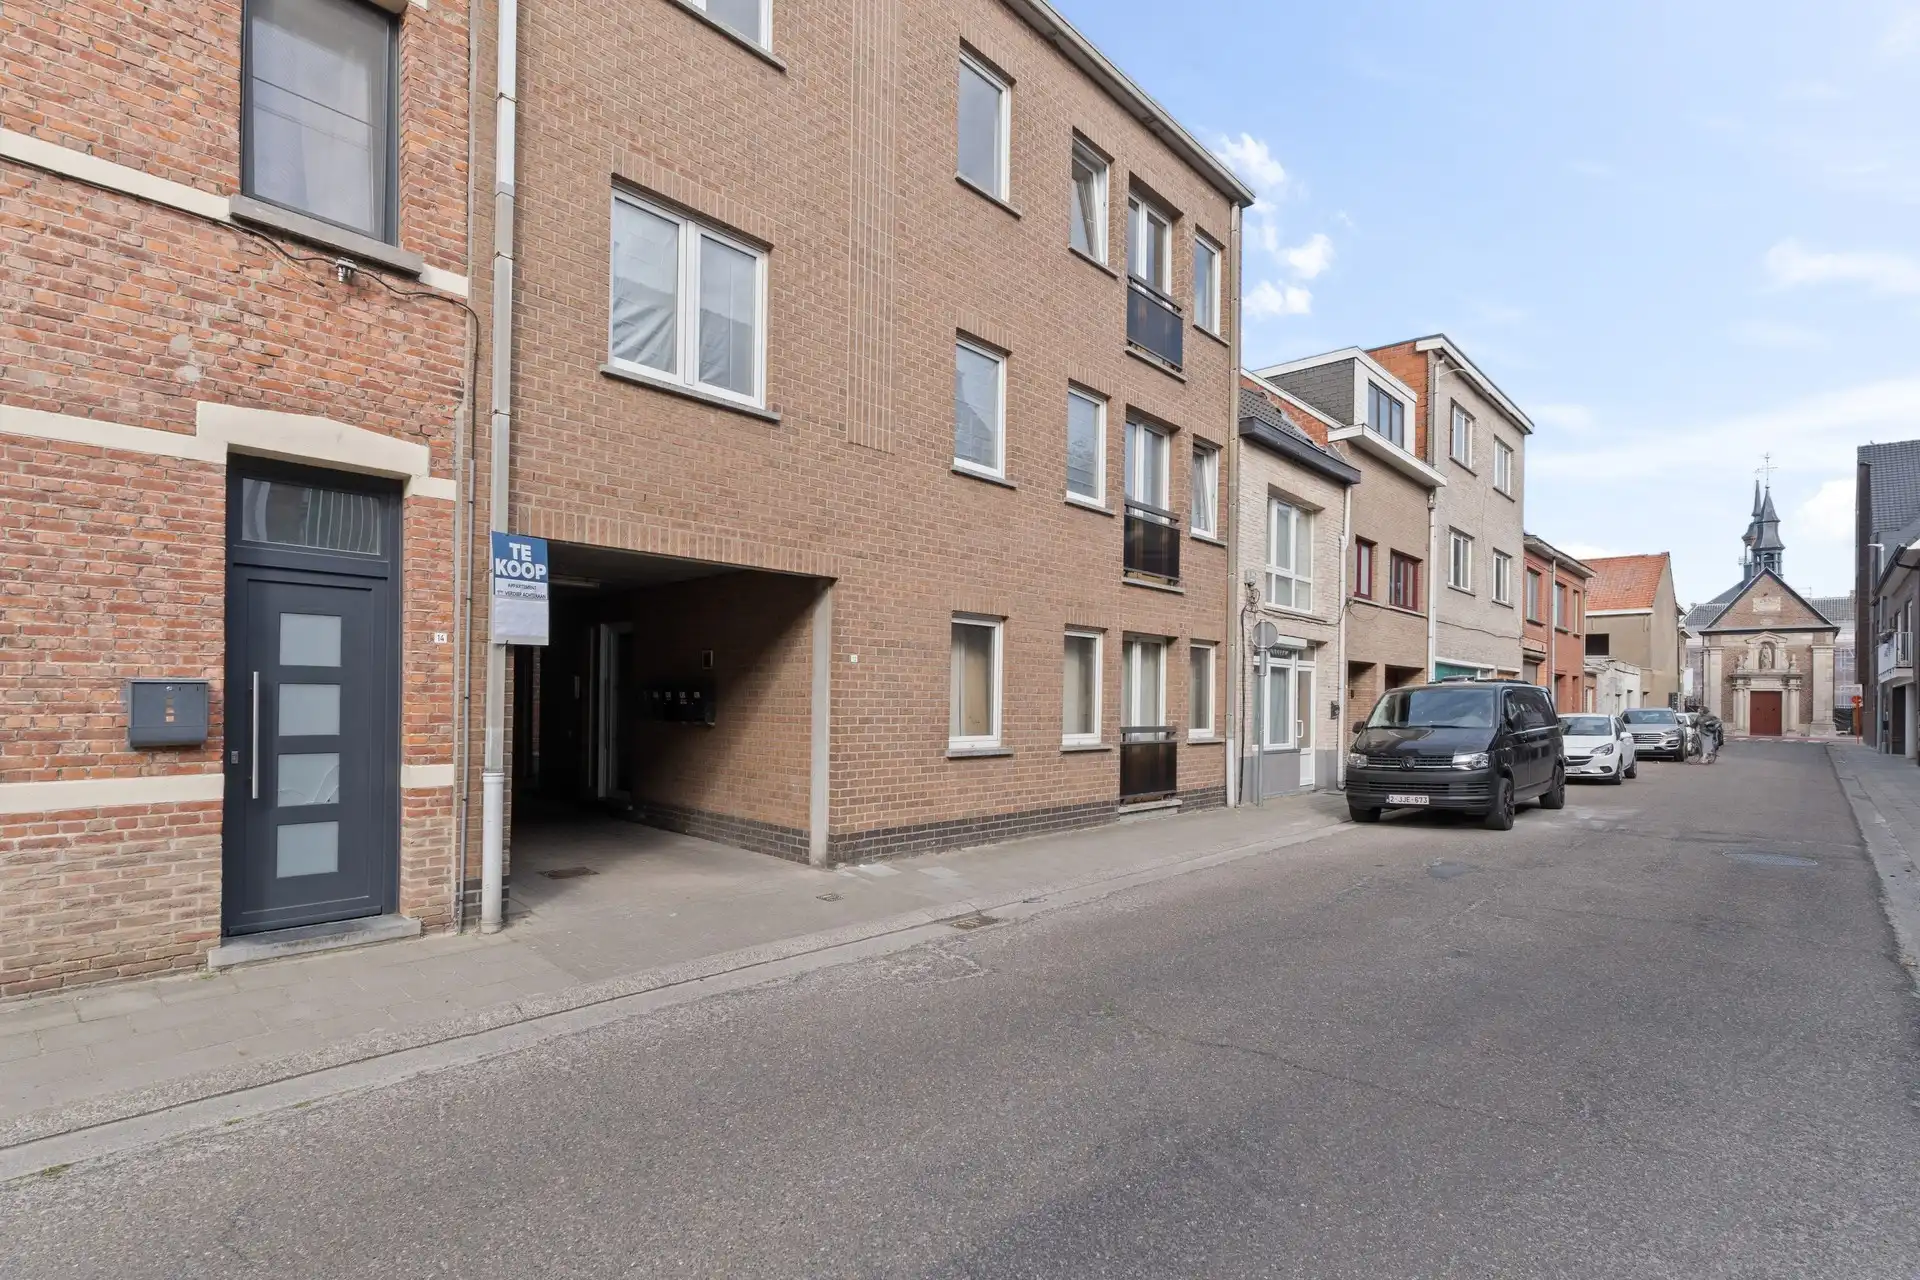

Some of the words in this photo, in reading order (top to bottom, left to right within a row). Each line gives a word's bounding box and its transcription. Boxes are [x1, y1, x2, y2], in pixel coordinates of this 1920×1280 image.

[509, 542, 532, 562] TE
[495, 558, 547, 580] KOOP
[437, 634, 445, 642] 14
